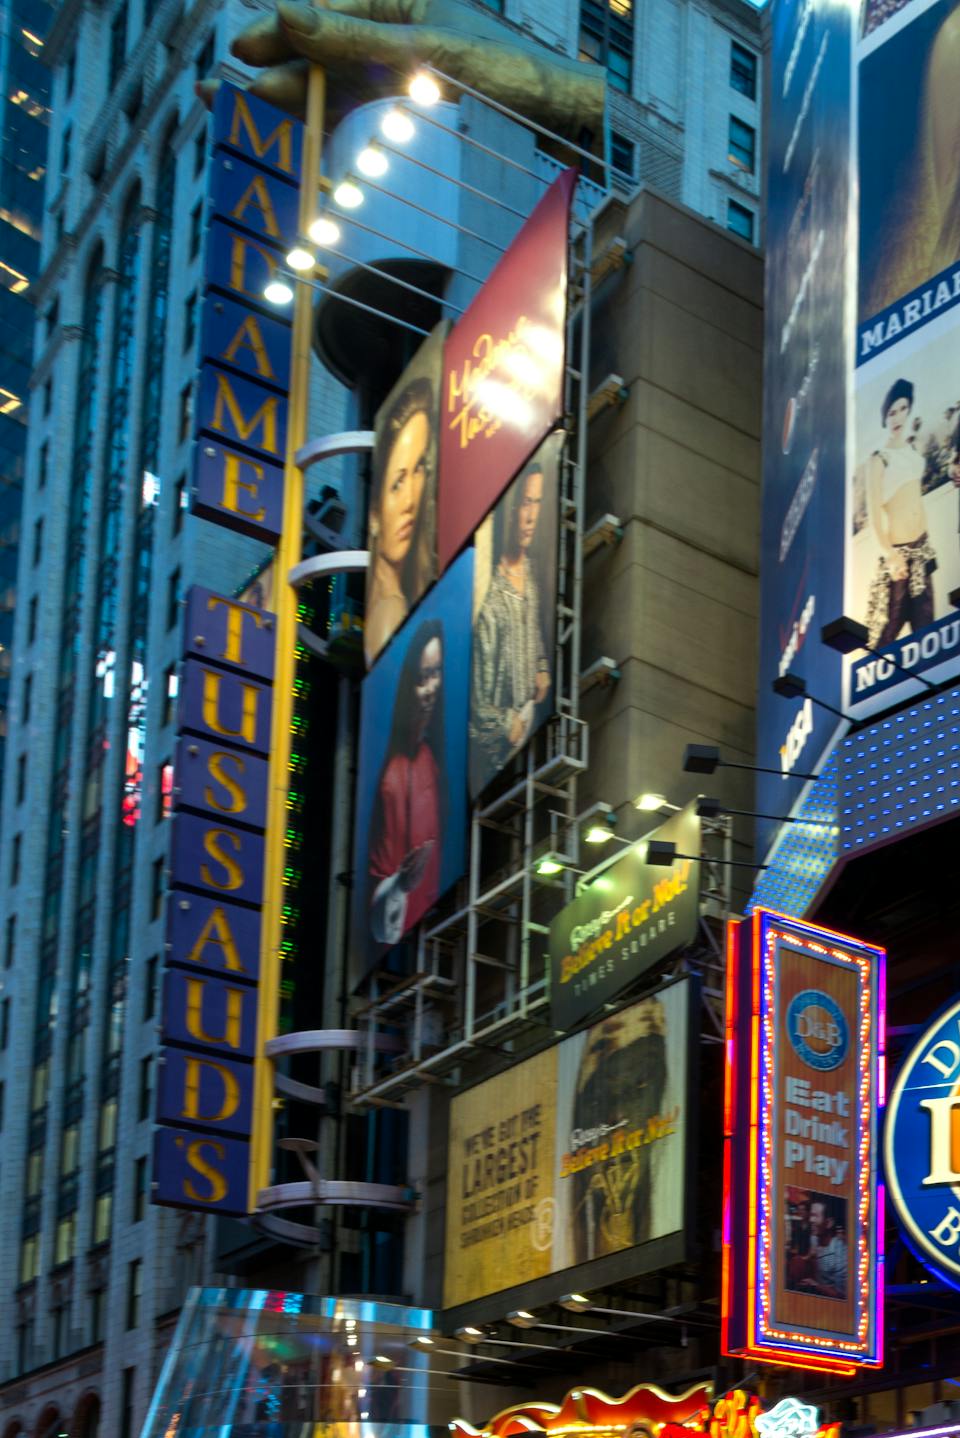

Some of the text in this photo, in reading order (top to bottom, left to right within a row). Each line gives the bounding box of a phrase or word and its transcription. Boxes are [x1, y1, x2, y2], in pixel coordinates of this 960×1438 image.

[209, 91, 293, 522] MADAME
[855, 653, 896, 693] NO
[175, 595, 261, 1203] TUSSAUD'S
[574, 911, 676, 997] TIMES SQUARE
[785, 1076, 849, 1117] Eat
[785, 1109, 849, 1148] Drink
[462, 1132, 541, 1199] LARGEST
[784, 1140, 849, 1185] Play
